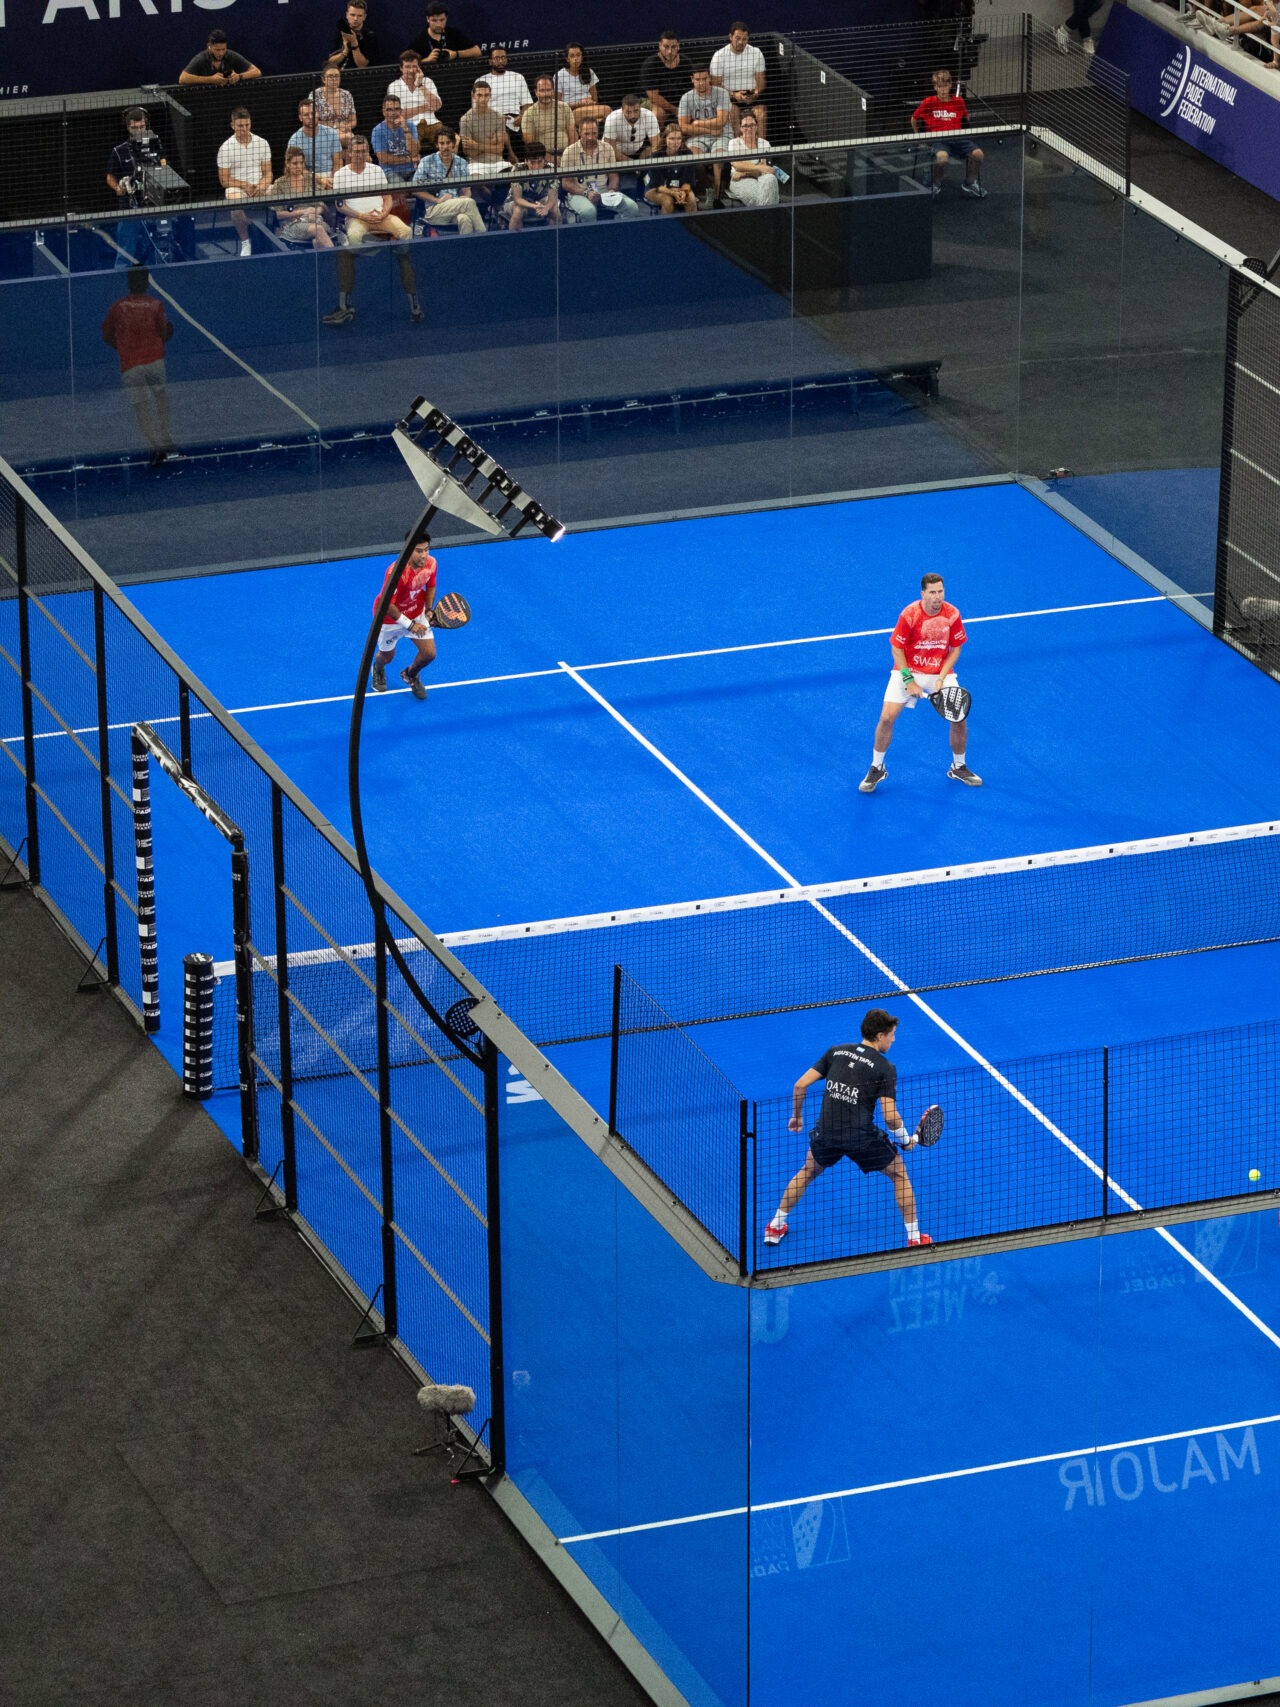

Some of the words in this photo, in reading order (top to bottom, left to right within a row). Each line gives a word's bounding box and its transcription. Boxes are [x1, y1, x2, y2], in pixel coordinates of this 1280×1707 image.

[480, 39, 529, 51] REMIER
[1190, 64, 1238, 106] INTERNATIONAL
[1183, 82, 1205, 108] PADEL
[1177, 99, 1216, 135] FEDERATION
[858, 1056, 875, 1068] TAPIA
[826, 1080, 859, 1099] QATAR
[829, 1092, 858, 1105] AIRWAYS
